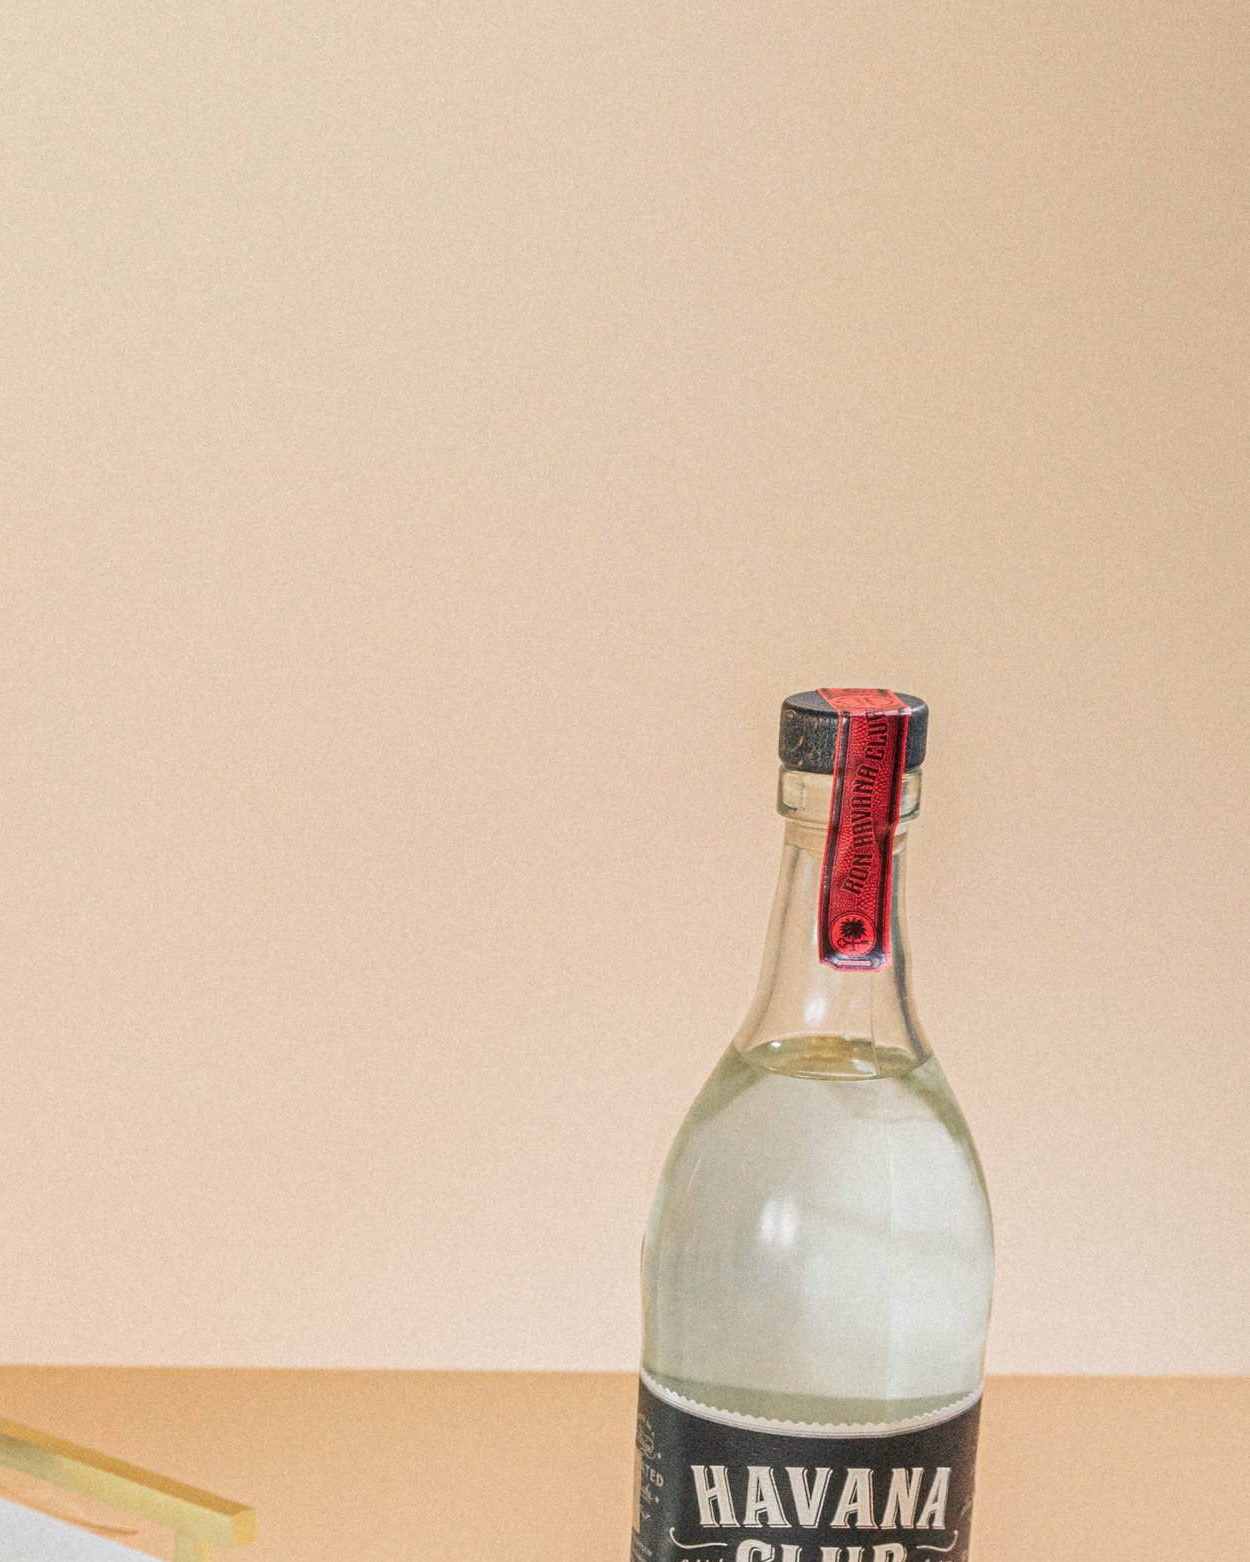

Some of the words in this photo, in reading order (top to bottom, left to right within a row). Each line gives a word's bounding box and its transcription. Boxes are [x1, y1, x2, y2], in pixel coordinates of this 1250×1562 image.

[851, 764, 879, 848] HAVANA
[842, 853, 873, 895] RON
[691, 1465, 951, 1530] HAVANA
